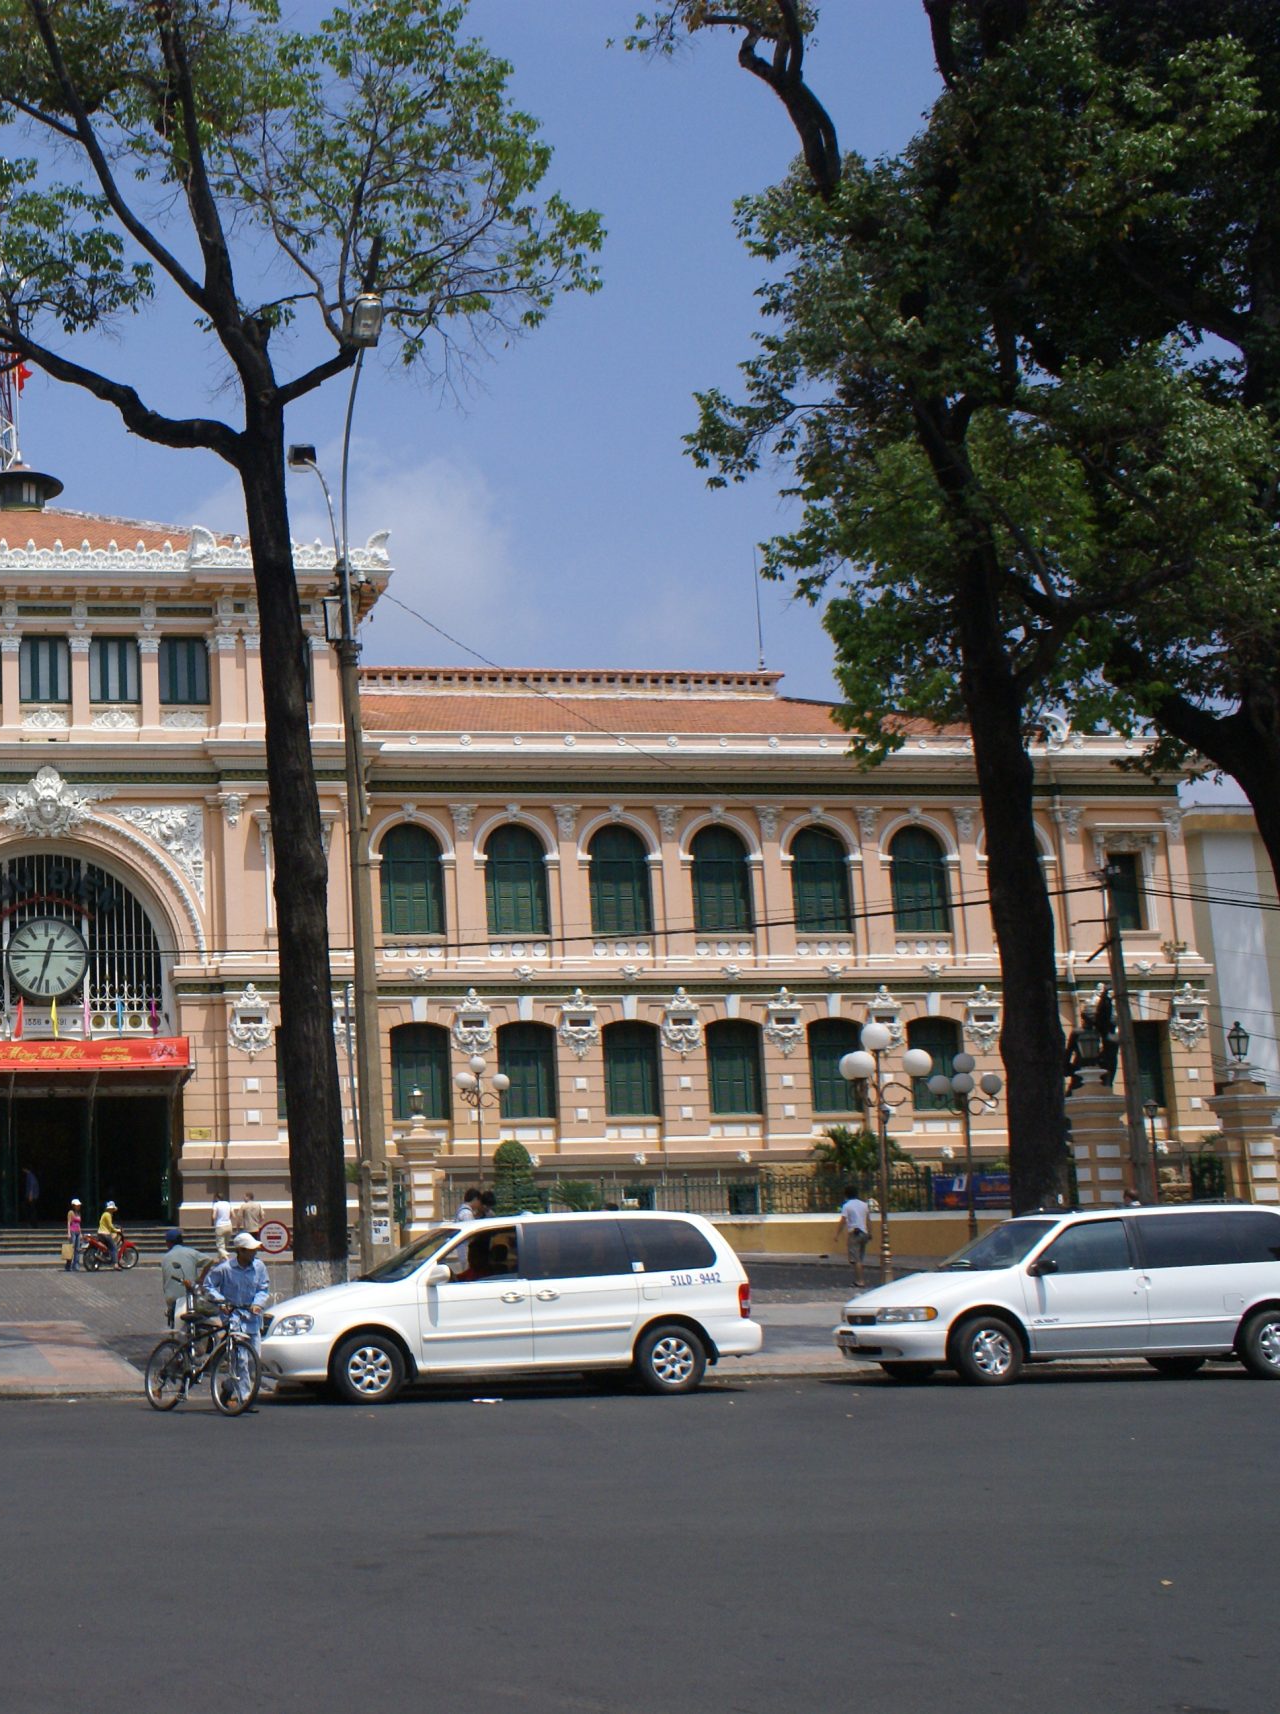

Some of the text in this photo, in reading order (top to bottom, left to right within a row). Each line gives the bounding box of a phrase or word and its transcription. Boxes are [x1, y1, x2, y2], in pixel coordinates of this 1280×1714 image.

[305, 1204, 317, 1216] 10
[671, 1274, 692, 1286] 51LD
[700, 1272, 721, 1285] 9442
